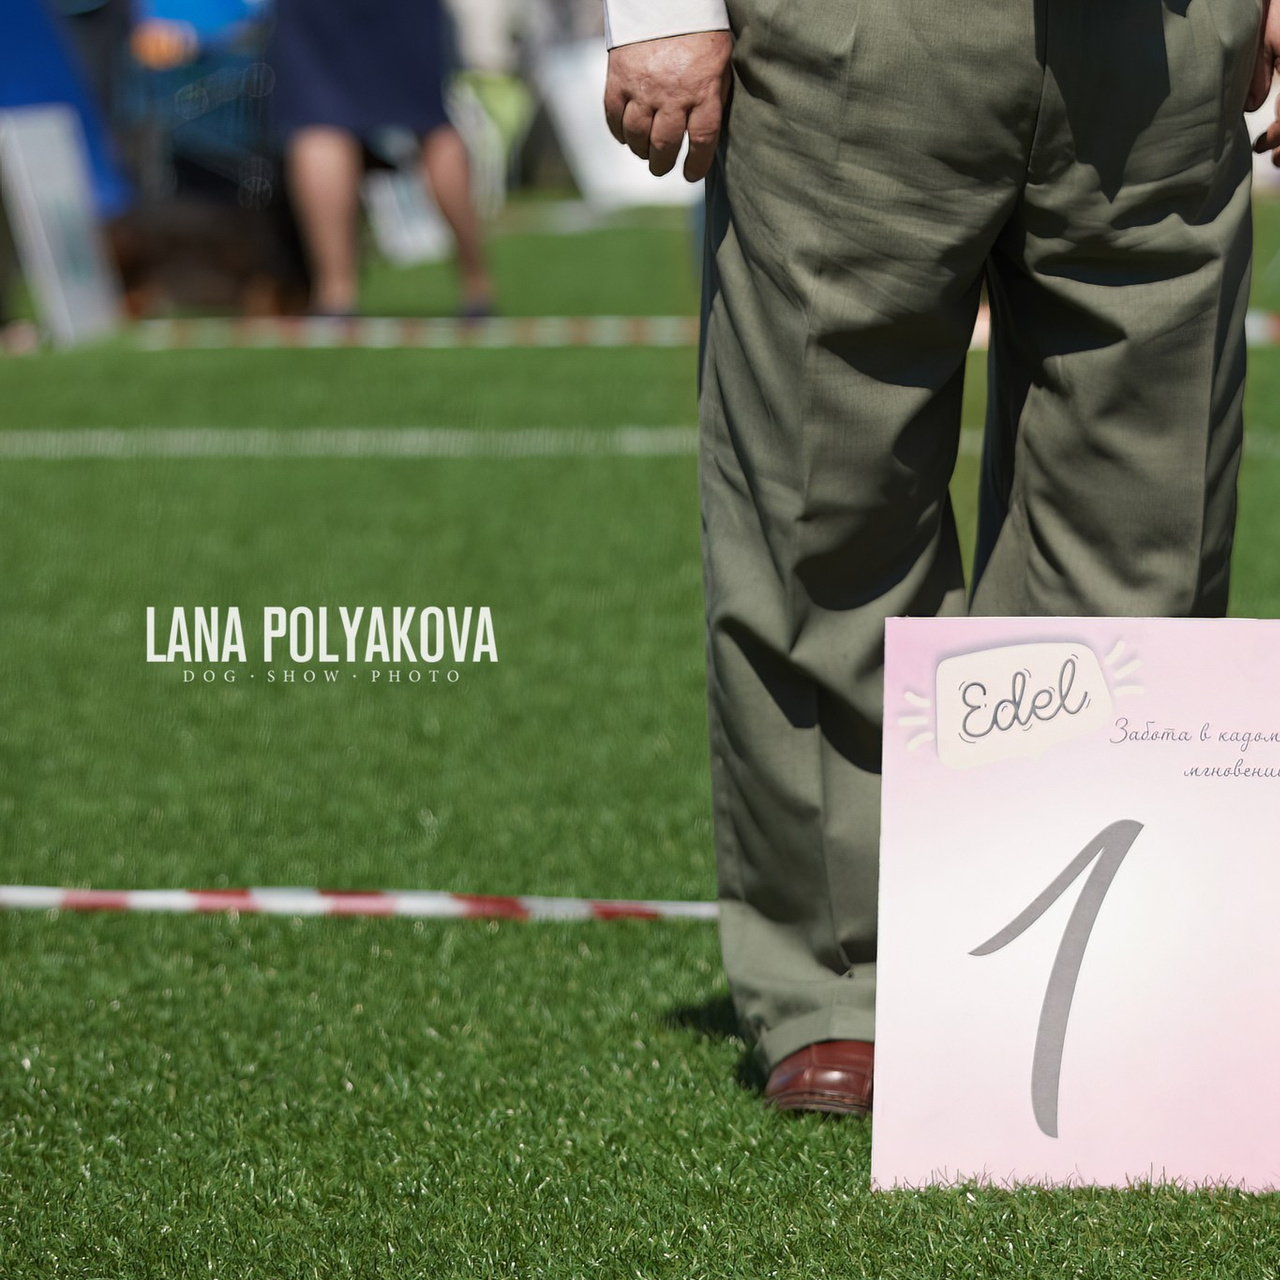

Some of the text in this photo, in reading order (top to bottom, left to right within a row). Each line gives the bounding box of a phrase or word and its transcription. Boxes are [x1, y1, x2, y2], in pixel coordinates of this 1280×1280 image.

[962, 657, 1089, 739] Edel
[1109, 718, 1191, 744] Забота
[1200, 722, 1211, 743] в
[968, 819, 1145, 1138] 1
